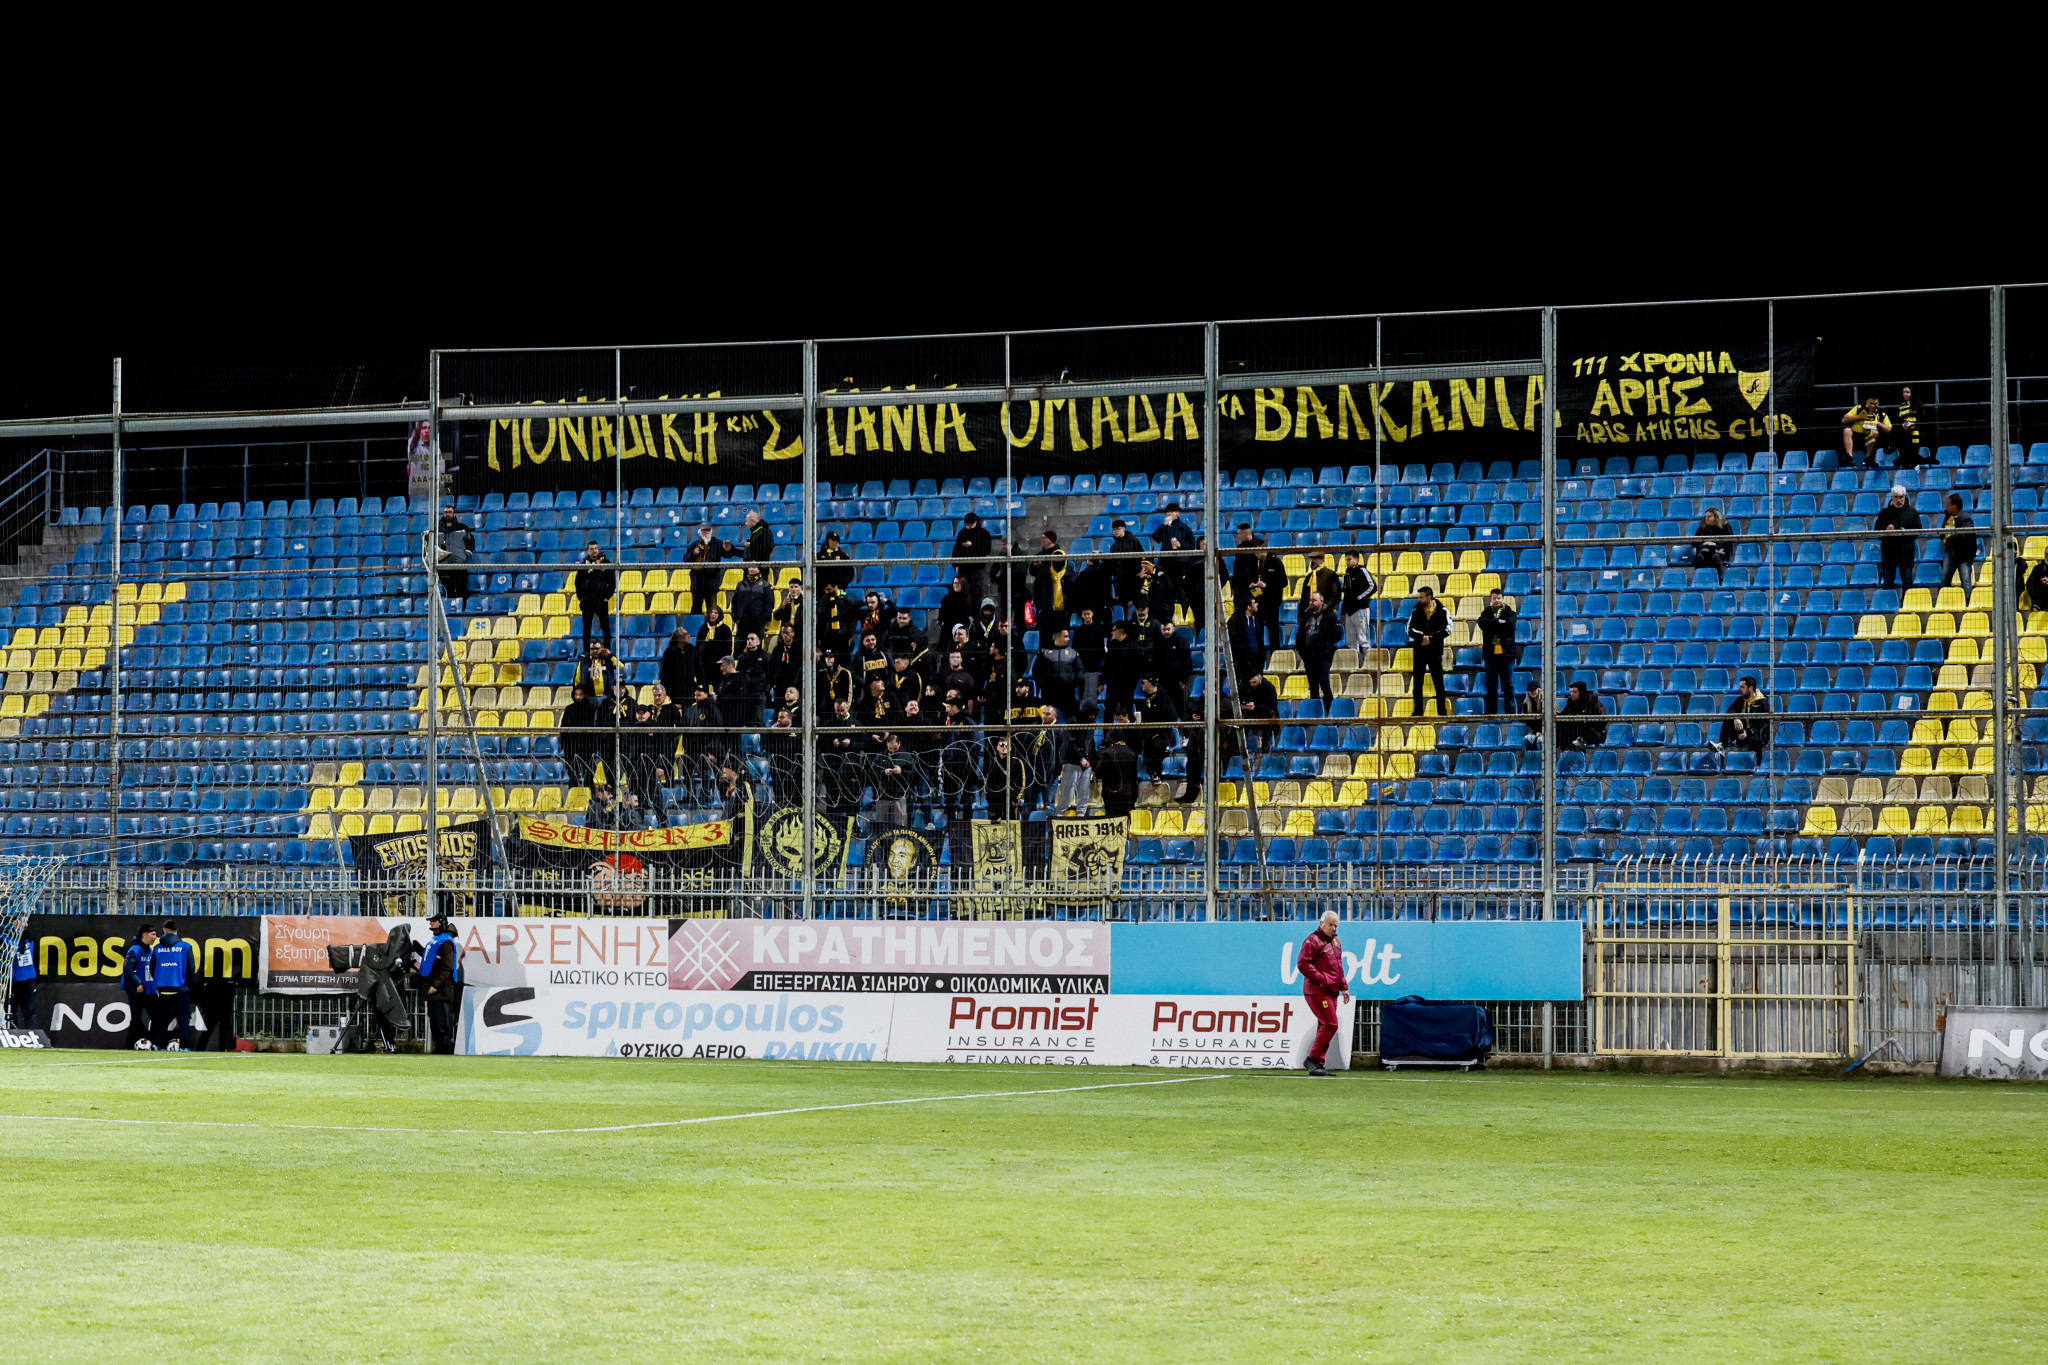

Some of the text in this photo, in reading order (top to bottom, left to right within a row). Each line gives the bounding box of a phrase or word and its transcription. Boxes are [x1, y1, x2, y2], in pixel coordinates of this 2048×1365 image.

[1572, 351, 1737, 378] 111 ΧΡΟΝΙΑ
[1590, 376, 1713, 417] ΑΡΗΣ
[1000, 390, 1199, 452] ΟΜΑΔΑ
[1729, 413, 1797, 440] CLUB
[527, 820, 724, 850] SUPER 3
[1055, 822, 1125, 839] ARIS 1914
[274, 924, 330, 942] Σίγουρη
[458, 925, 667, 966] ΑΡΣΕΝΗΣ
[753, 925, 1094, 967] ΚΡΑΤΗΜΕΝΟΣ
[275, 975, 299, 983] ΤΕΡΜΑ
[550, 970, 667, 986] ΙΔΙΩΤΙΚΟ ΚΤΕΟ
[753, 974, 1106, 994] ΕΠΕΞΕΡΓΑΣΙΑ ΣΙΔΗΡΟΥ ΟΙΚΟΔΟΜΙΚΑ ΥΛΙΚΑ
[50, 1001, 208, 1033] NOA
[562, 993, 846, 1040] spiropoulos
[949, 996, 1099, 1031] Promist
[1152, 1001, 1293, 1033] Promist
[620, 1043, 746, 1059] ΦΥΣΙΚΟ ΑΕΡΙΟ
[762, 1041, 877, 1062] DAIKIN
[948, 1036, 1096, 1048] INSURANCE
[1152, 1037, 1291, 1049] INSURANCE
[965, 1055, 1054, 1065] FINANCE
[1150, 1055, 1290, 1067] & FINANCE S.A.
